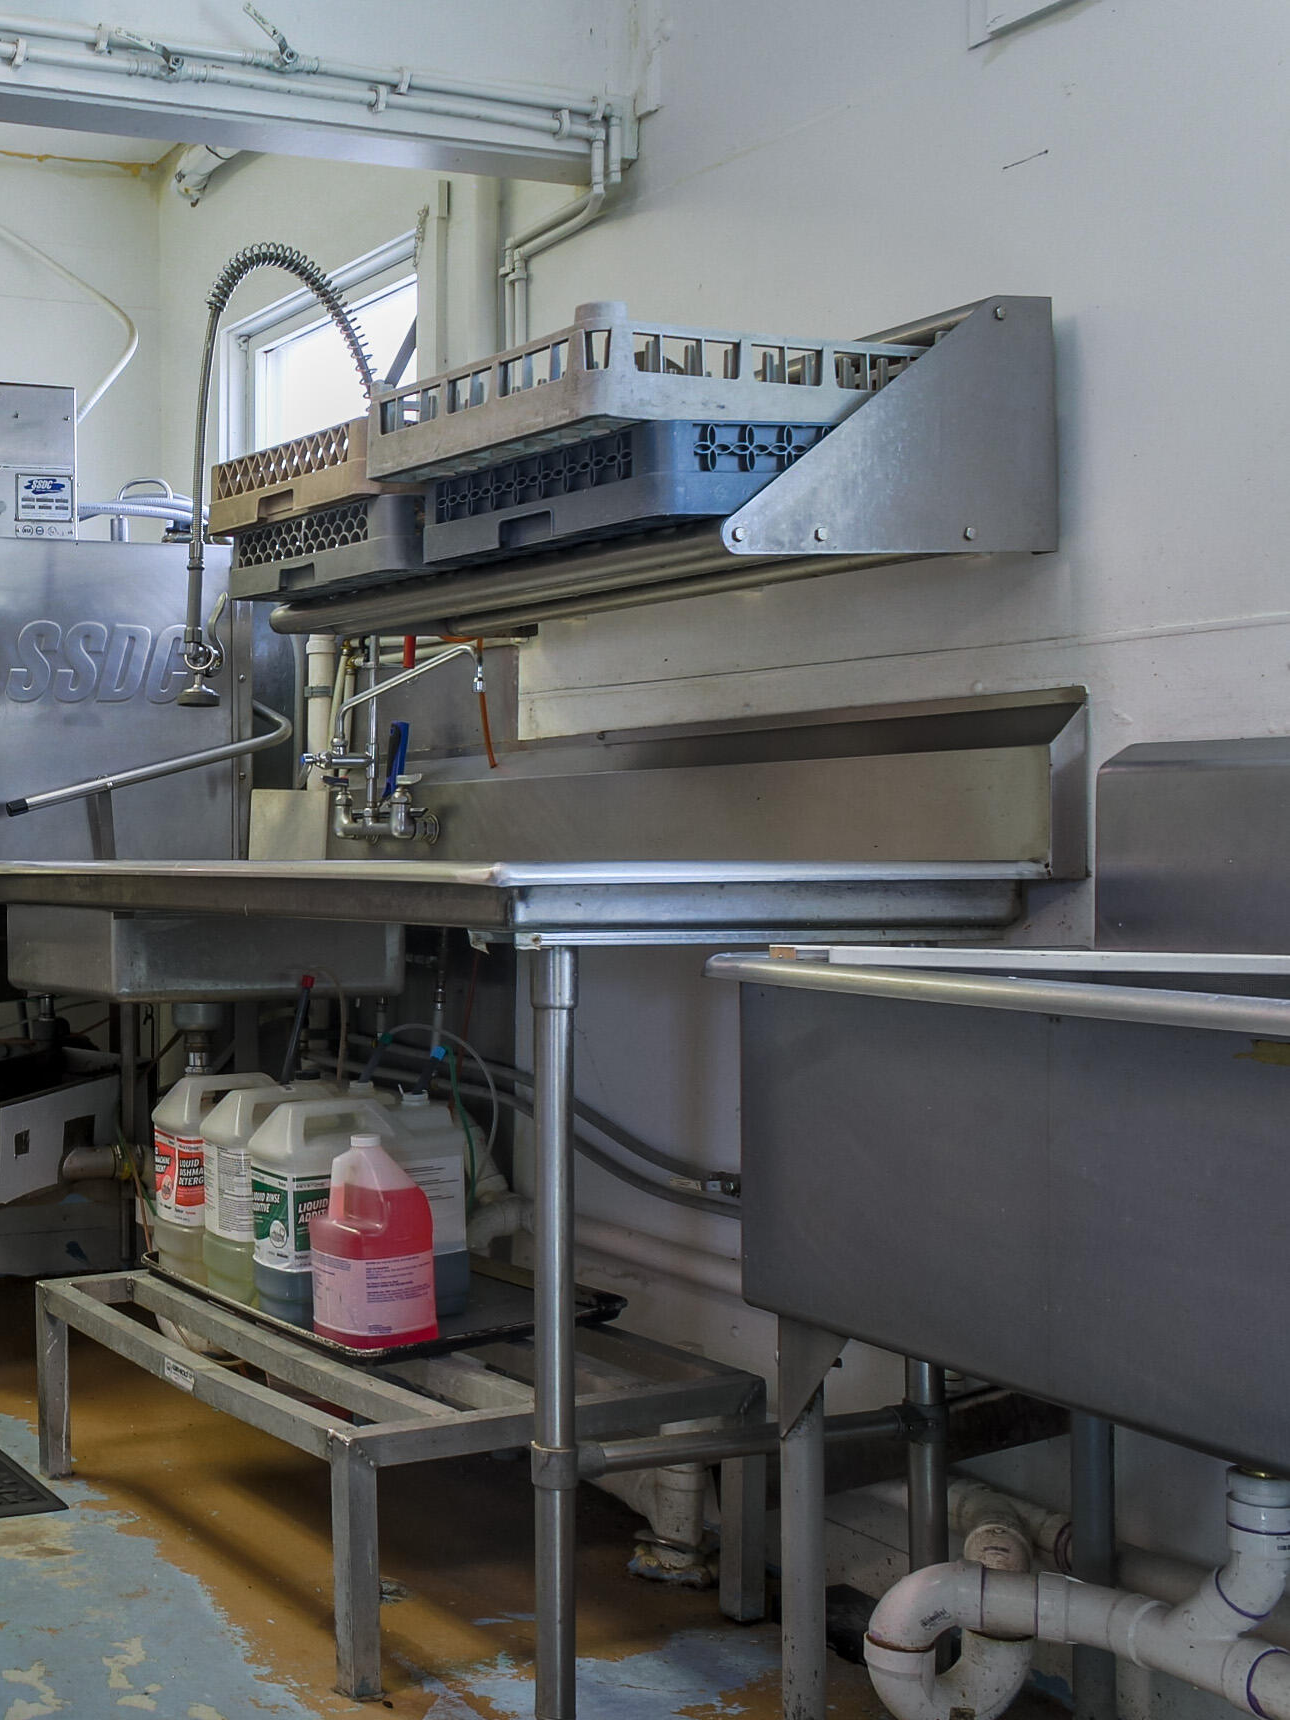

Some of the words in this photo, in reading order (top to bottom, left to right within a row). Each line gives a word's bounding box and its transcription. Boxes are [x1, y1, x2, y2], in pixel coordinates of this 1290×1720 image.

[31, 479, 54, 489] SSDC
[5, 619, 190, 704] SSDC
[179, 1159, 200, 1168] LIQUID
[179, 1167, 204, 1177] DISHMA
[178, 1176, 204, 1187] DETERG
[298, 1197, 329, 1214] LIQUID
[298, 1209, 327, 1225] ADDIT
